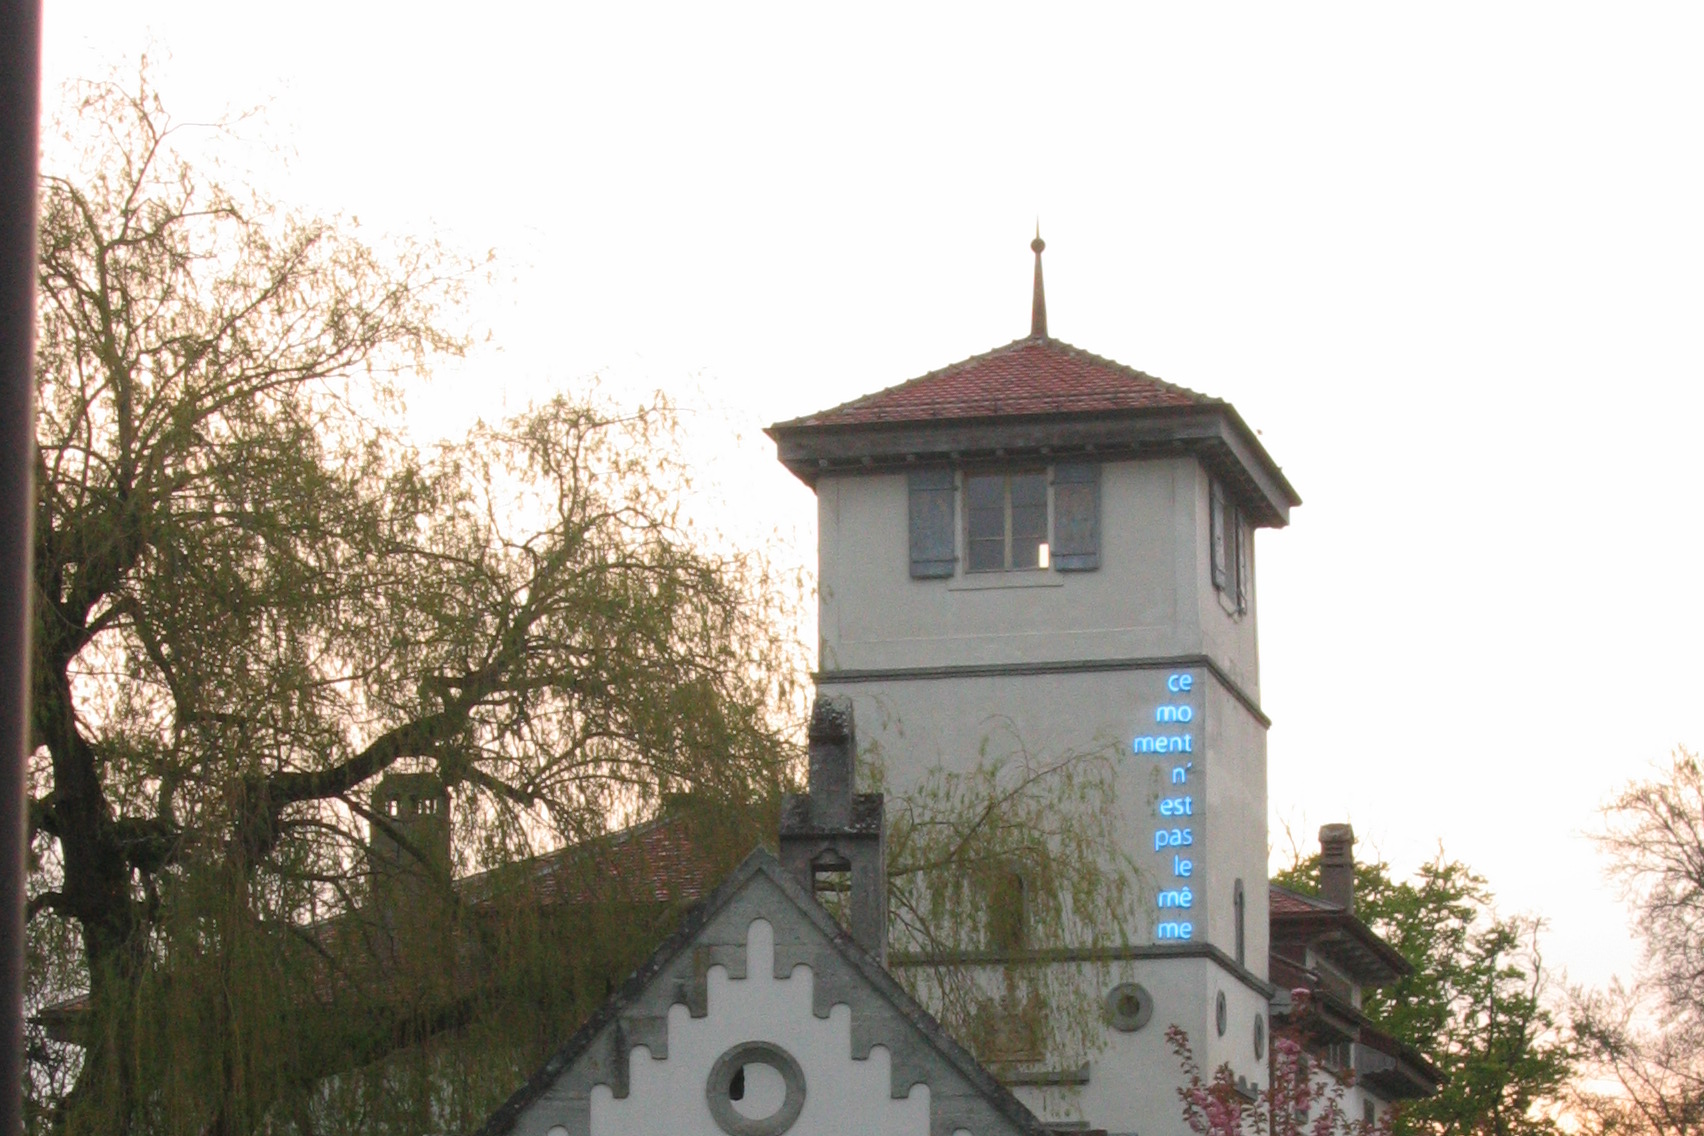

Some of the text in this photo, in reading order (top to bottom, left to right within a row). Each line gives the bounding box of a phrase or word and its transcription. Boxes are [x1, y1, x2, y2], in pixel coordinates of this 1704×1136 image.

[1167, 673, 1193, 692] ce
[1155, 705, 1193, 722] mo
[1133, 733, 1193, 753] ment
[1159, 795, 1193, 815] est
[1154, 828, 1193, 851] pas
[1173, 854, 1193, 877] le
[1157, 886, 1193, 908] mê
[1157, 921, 1193, 939] me
